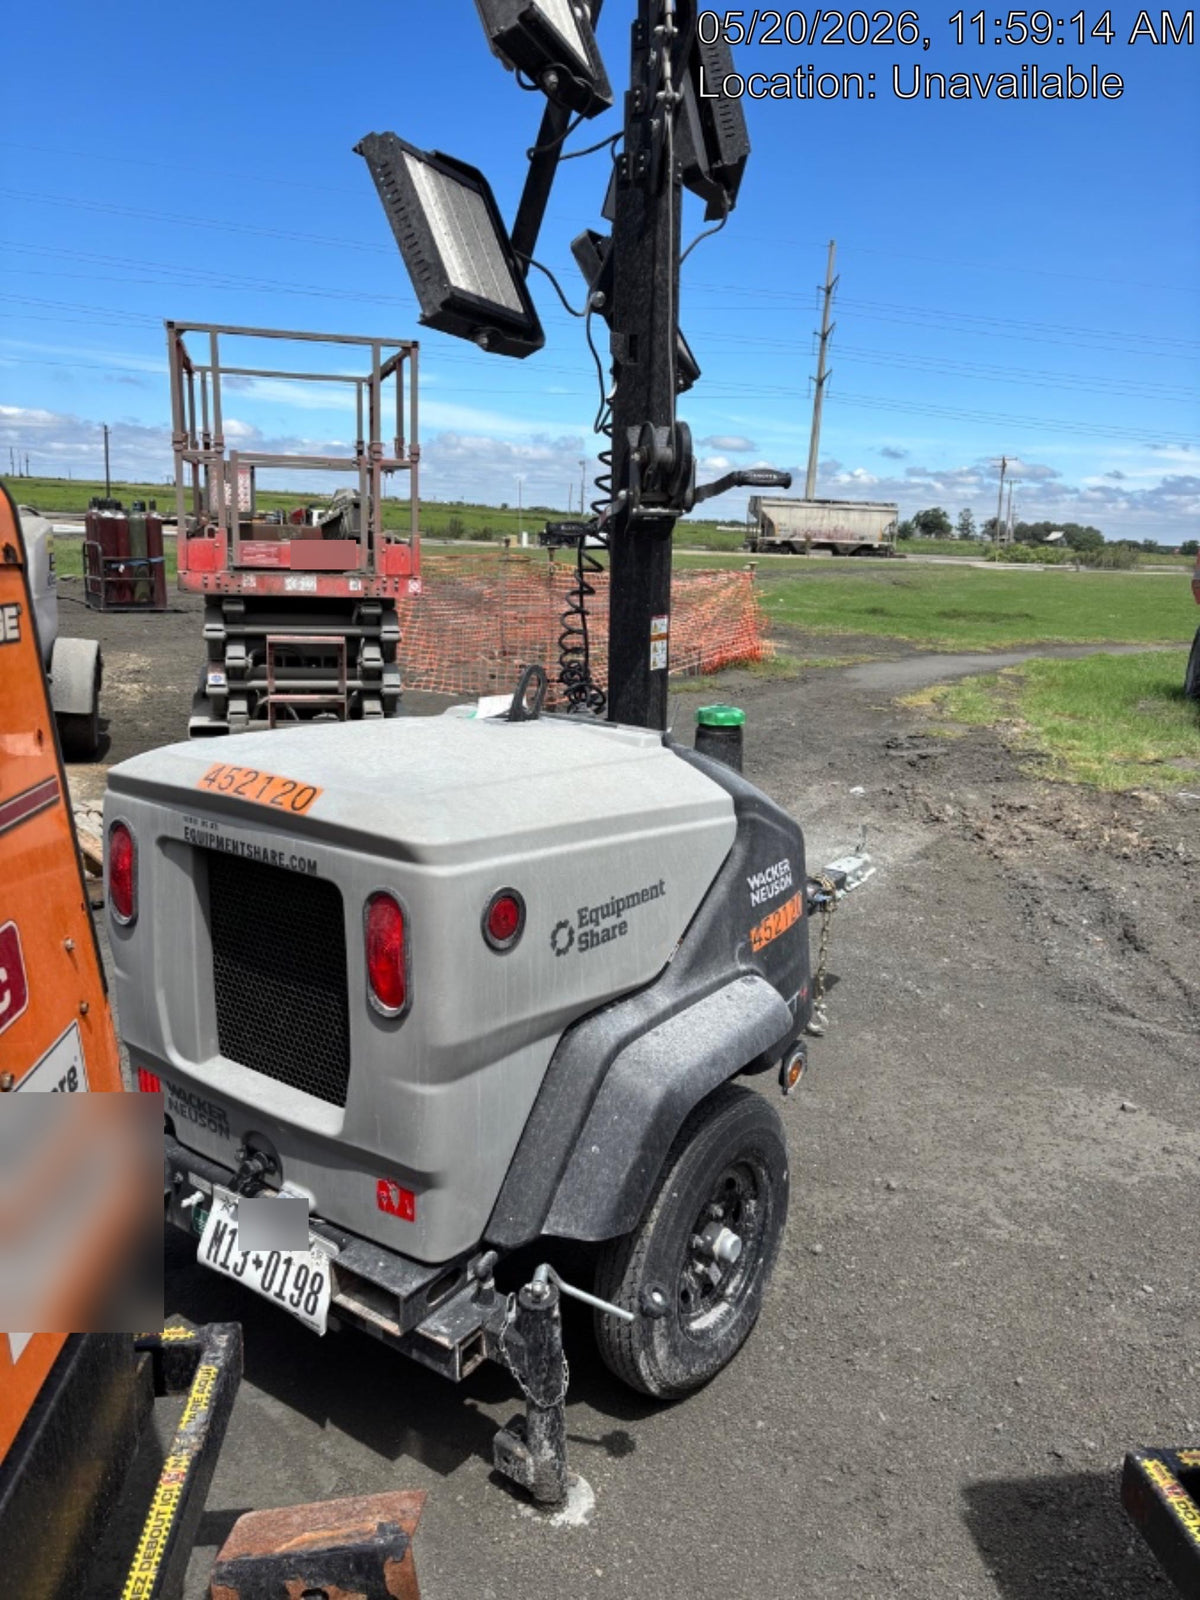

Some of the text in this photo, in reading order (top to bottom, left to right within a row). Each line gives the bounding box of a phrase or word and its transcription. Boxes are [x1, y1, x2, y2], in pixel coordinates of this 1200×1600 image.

[203, 764, 318, 812] 452120
[183, 826, 318, 875] EQUIPMENTSHARE.COM
[746, 858, 791, 891] WACKER
[750, 873, 793, 908] NEUSON
[577, 879, 666, 928] Equipment
[577, 920, 629, 953] Share
